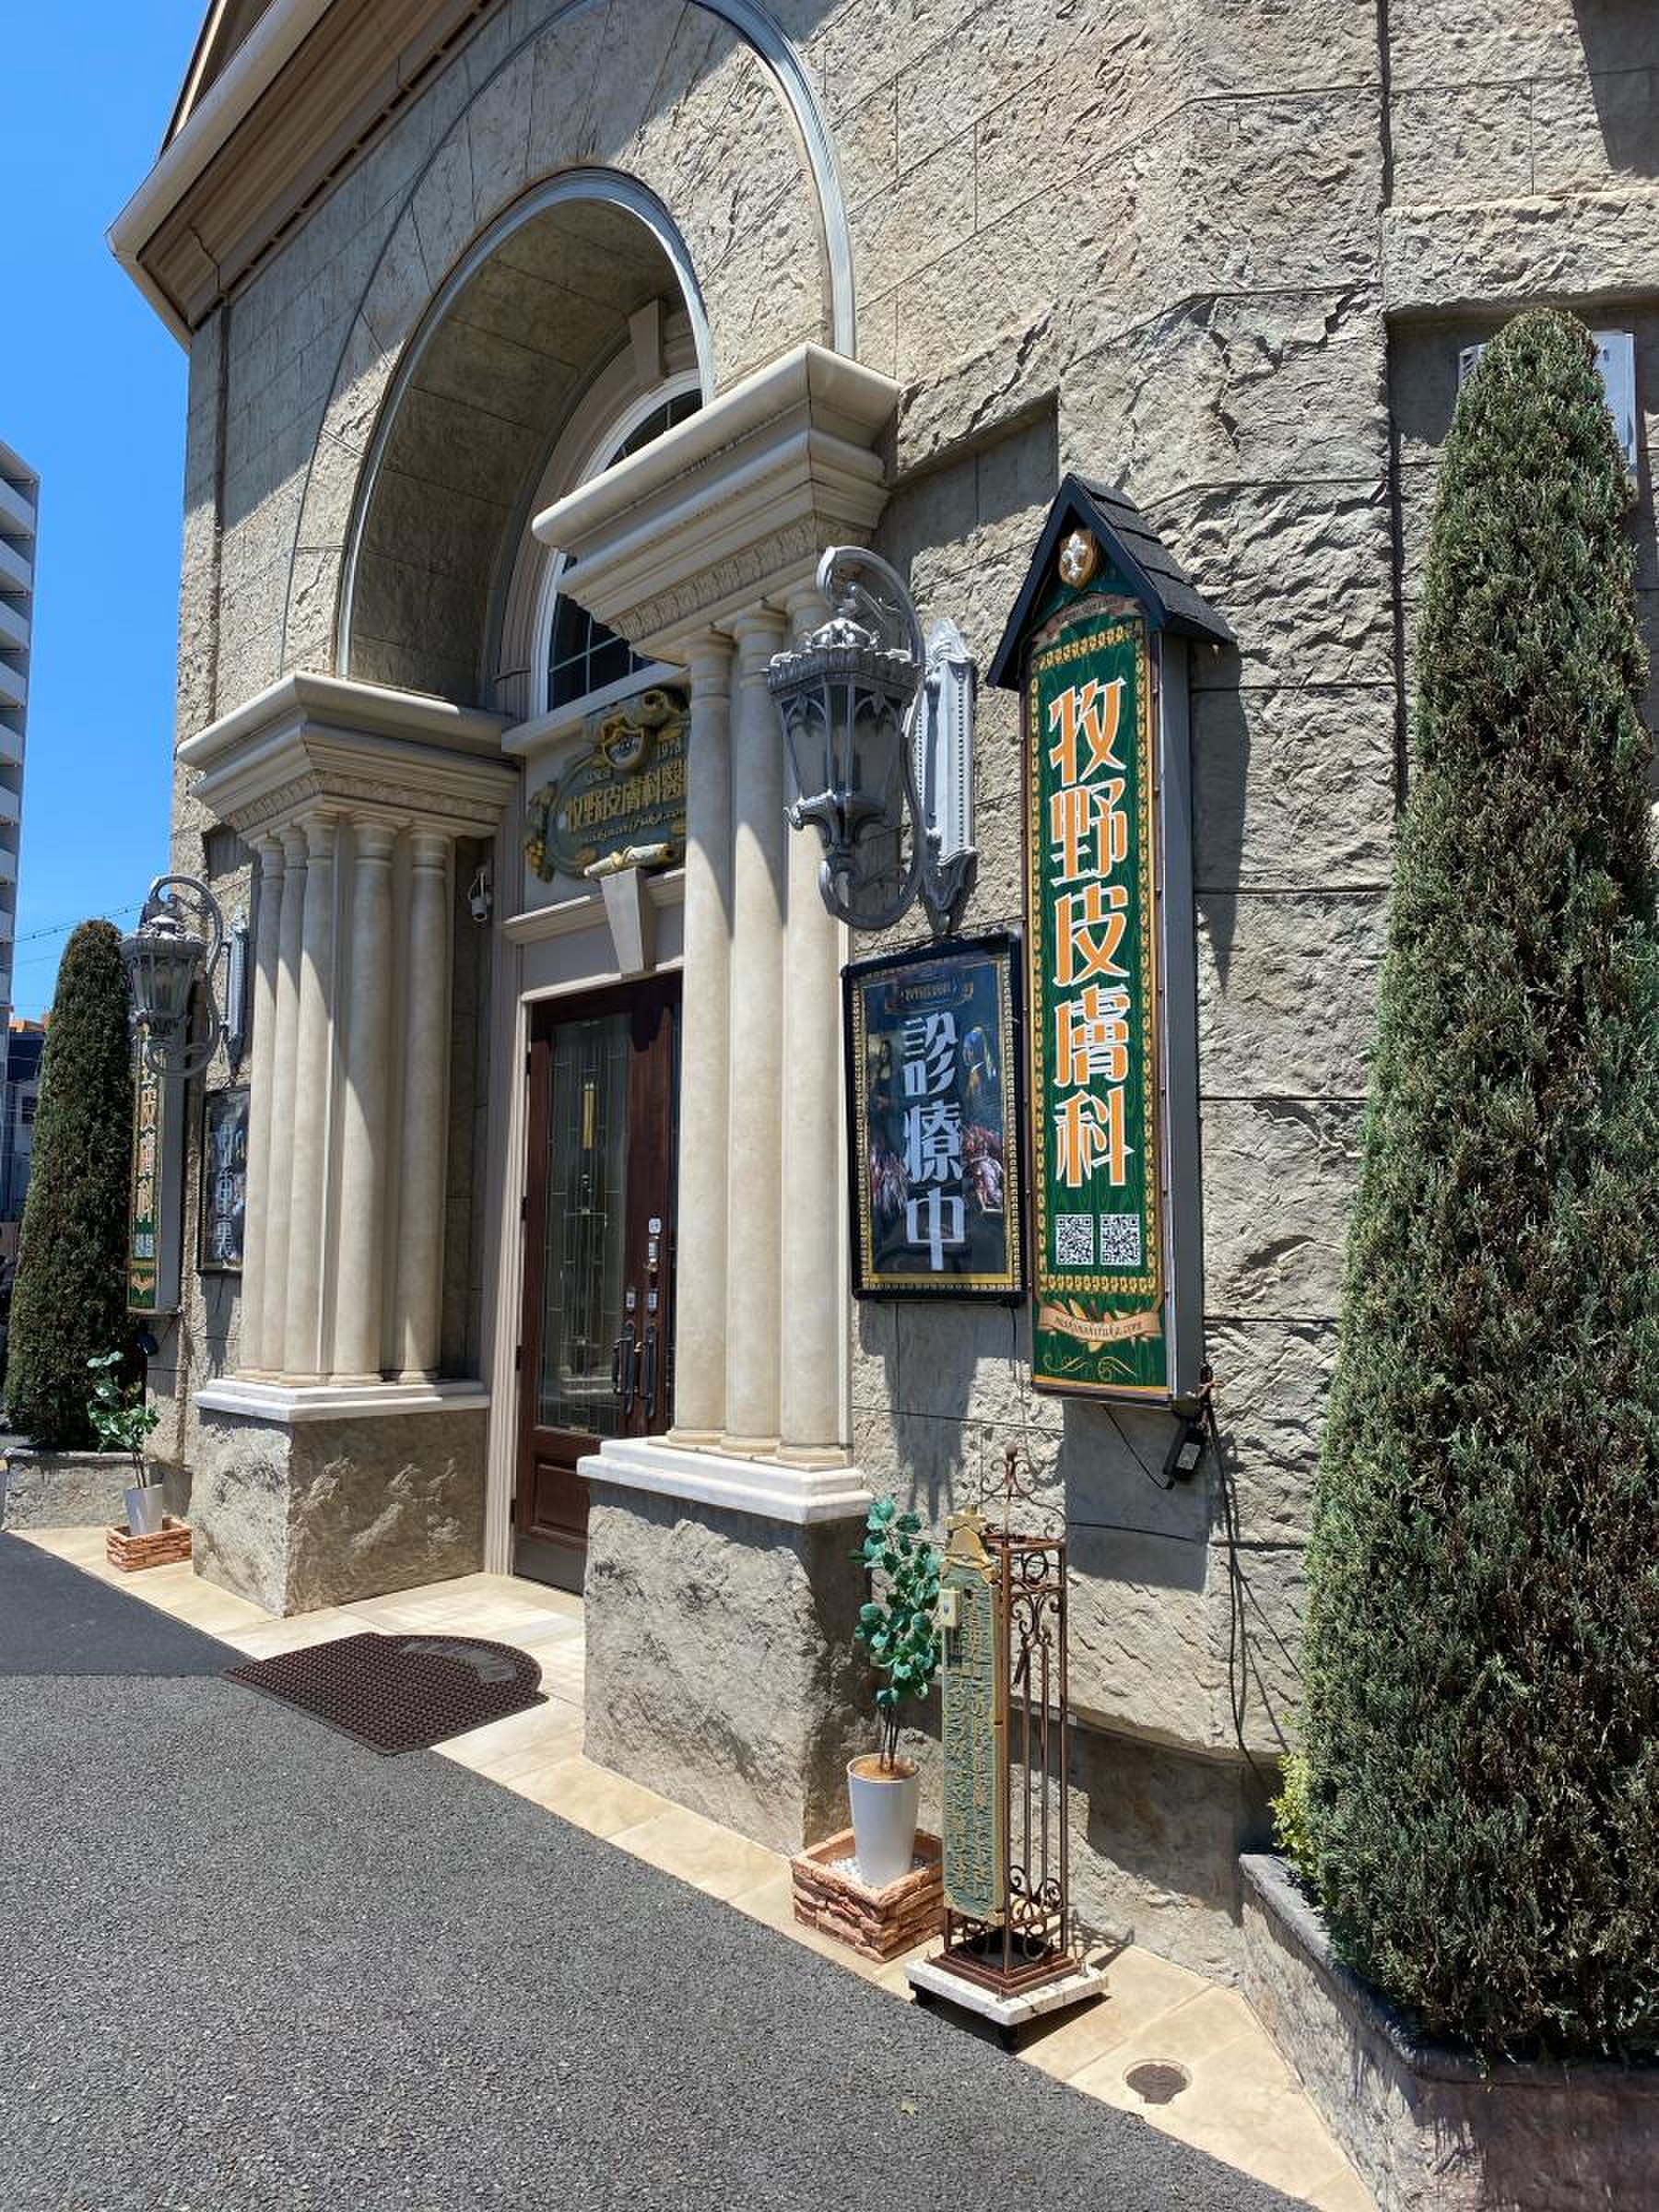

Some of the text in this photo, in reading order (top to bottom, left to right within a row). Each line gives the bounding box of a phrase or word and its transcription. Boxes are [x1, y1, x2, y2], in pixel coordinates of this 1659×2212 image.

[1048, 677, 1135, 1189] 牧野皮膚科
[901, 1011, 967, 1271] 診療中
